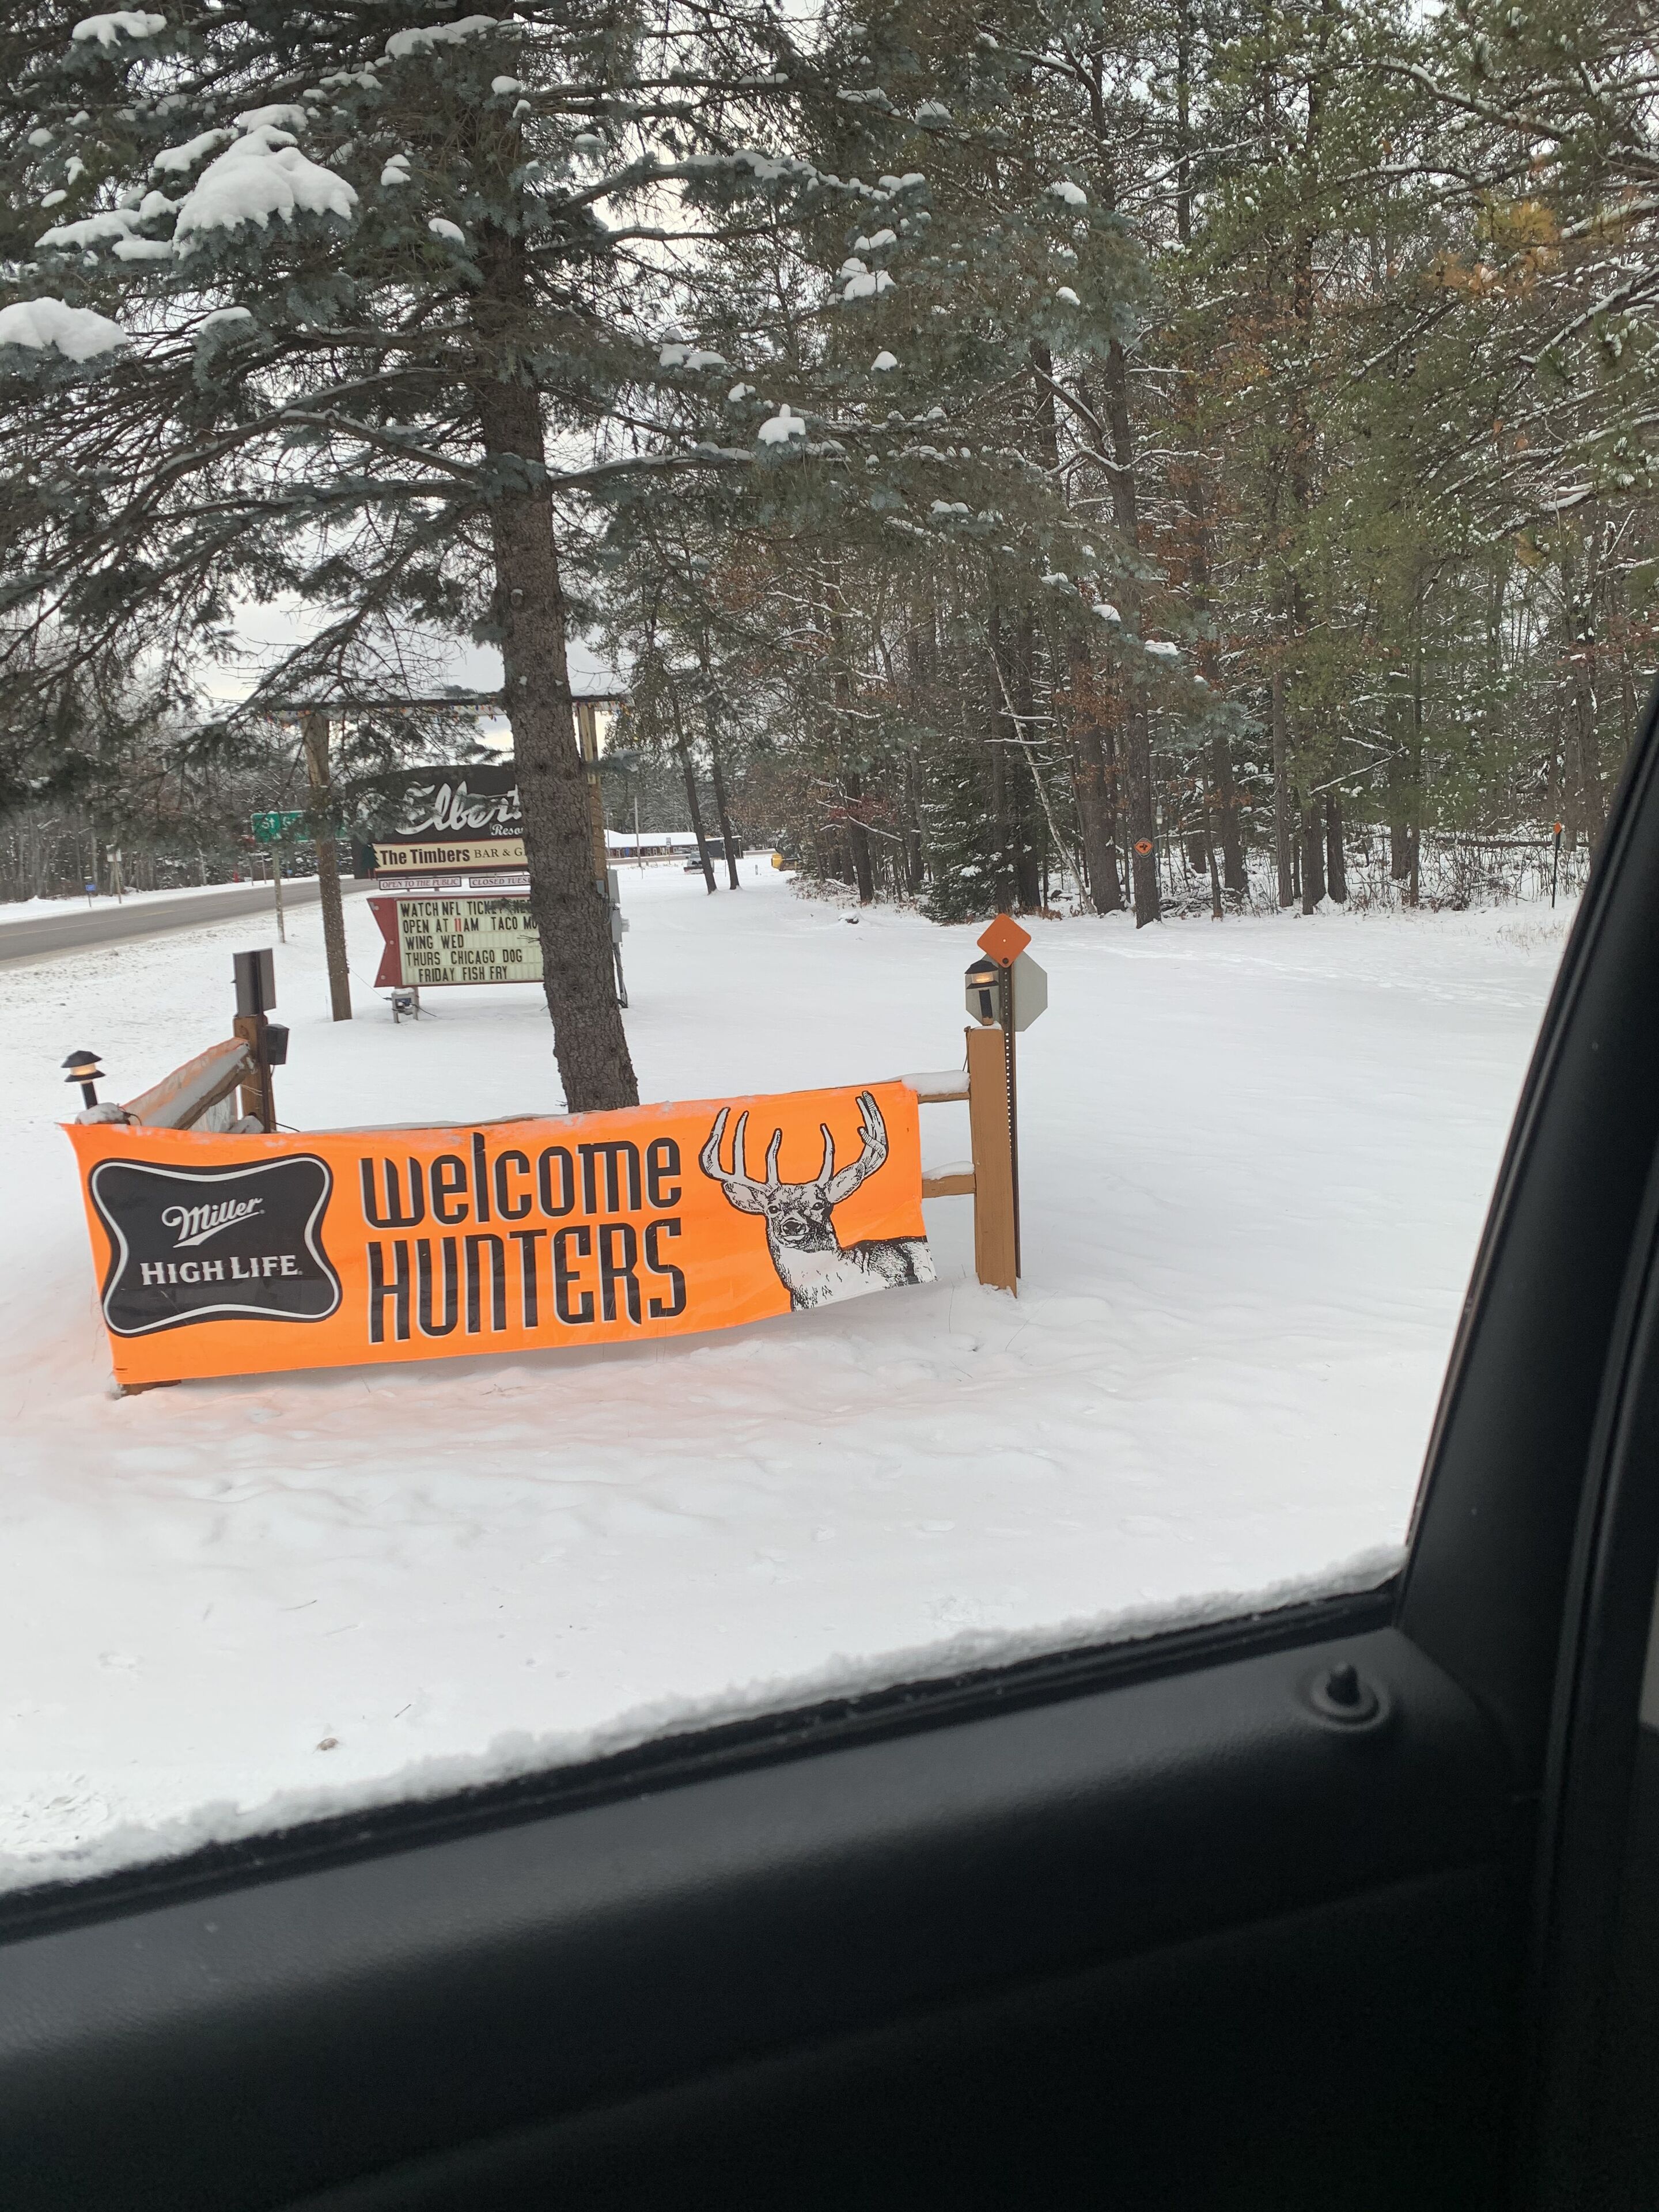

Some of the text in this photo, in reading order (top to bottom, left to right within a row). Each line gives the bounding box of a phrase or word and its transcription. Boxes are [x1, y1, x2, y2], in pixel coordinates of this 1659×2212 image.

[380, 850, 407, 865] The
[410, 848, 471, 864] Timbers
[474, 849, 499, 858] BAR
[502, 848, 511, 857] &
[382, 880, 403, 888] OPEN
[416, 879, 431, 887] THE
[432, 878, 460, 887] PUBLIC
[401, 902, 439, 917] WATCH
[442, 901, 461, 916] NFL
[403, 919, 429, 933] OPEN
[436, 918, 448, 933] AT
[491, 916, 518, 931] TACO
[405, 934, 464, 950] WING WED
[406, 949, 522, 966] THURS CHICAGO DOG
[419, 965, 507, 983] FRIDAY FISH FRY
[161, 1198, 263, 1241] Miller
[140, 1255, 298, 1286] HIGH LIFE
[367, 1217, 687, 1344] HUNTERS
